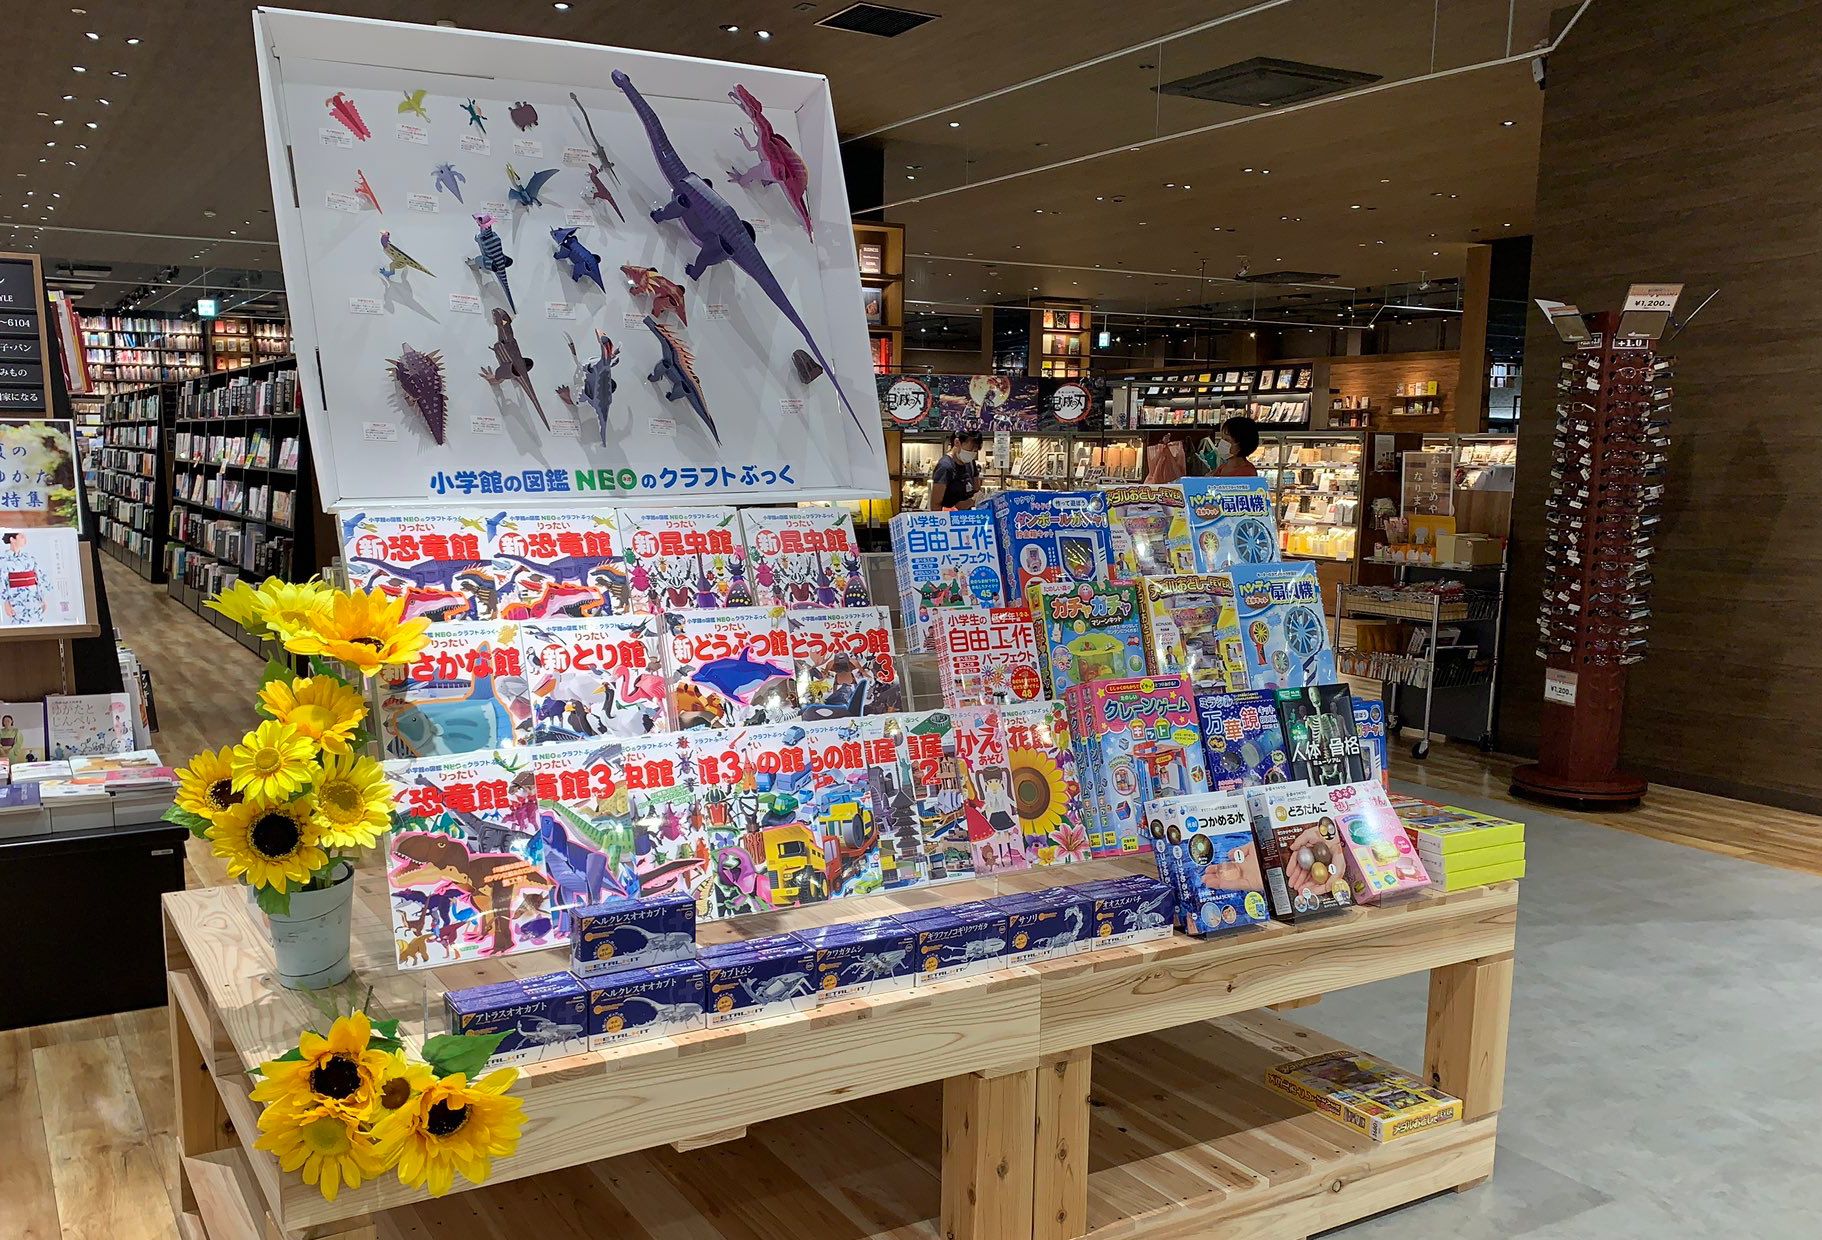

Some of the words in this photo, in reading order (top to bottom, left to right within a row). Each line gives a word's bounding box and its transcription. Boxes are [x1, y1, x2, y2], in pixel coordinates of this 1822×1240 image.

[1618, 339, 1642, 347] +1.0
[430, 470, 570, 495] 小学館の図鑑
[1, 491, 44, 508] 特集
[1222, 495, 1265, 512] 扇風機
[399, 522, 435, 532] りったい
[537, 521, 570, 530] りったい
[666, 520, 696, 528] りったい
[786, 519, 813, 527] りったい
[907, 515, 947, 527] 小学生の
[908, 526, 993, 552] 自由工作
[941, 552, 995, 565] パーフェクト
[1051, 595, 1131, 618] ガチャガチャ
[714, 622, 746, 632] りったい
[824, 621, 852, 629] りったい
[948, 613, 987, 627] 小学生の
[431, 639, 469, 648] りったい
[575, 632, 608, 641] りったい
[949, 624, 1033, 652] 自由工作
[982, 651, 1034, 665] パーフェクト
[876, 653, 895, 683] 3
[52, 704, 94, 715] ゆかたと
[1104, 696, 1190, 720] クレーンゲーム
[1003, 717, 1029, 725] りったい
[1202, 707, 1260, 741] 万華鏡
[1134, 725, 1166, 739] キット
[534, 759, 571, 770] りったい
[979, 754, 1004, 766] あそび
[439, 770, 478, 781] りったい
[920, 760, 941, 785] 2
[409, 779, 510, 818] 恐竜館
[1288, 801, 1327, 817] どろだんご
[1199, 812, 1245, 828] つかめる水
[1102, 896, 1141, 909] オオスズメバチ
[592, 907, 667, 925] ヘルクレスオオカブト
[1019, 914, 1038, 923] サソリ
[826, 946, 863, 959] クワガタムシ
[720, 965, 754, 979] カブトムシ
[601, 979, 677, 998] ヘルクレスオオカブト
[476, 1002, 547, 1025] アトラスオオカブト
